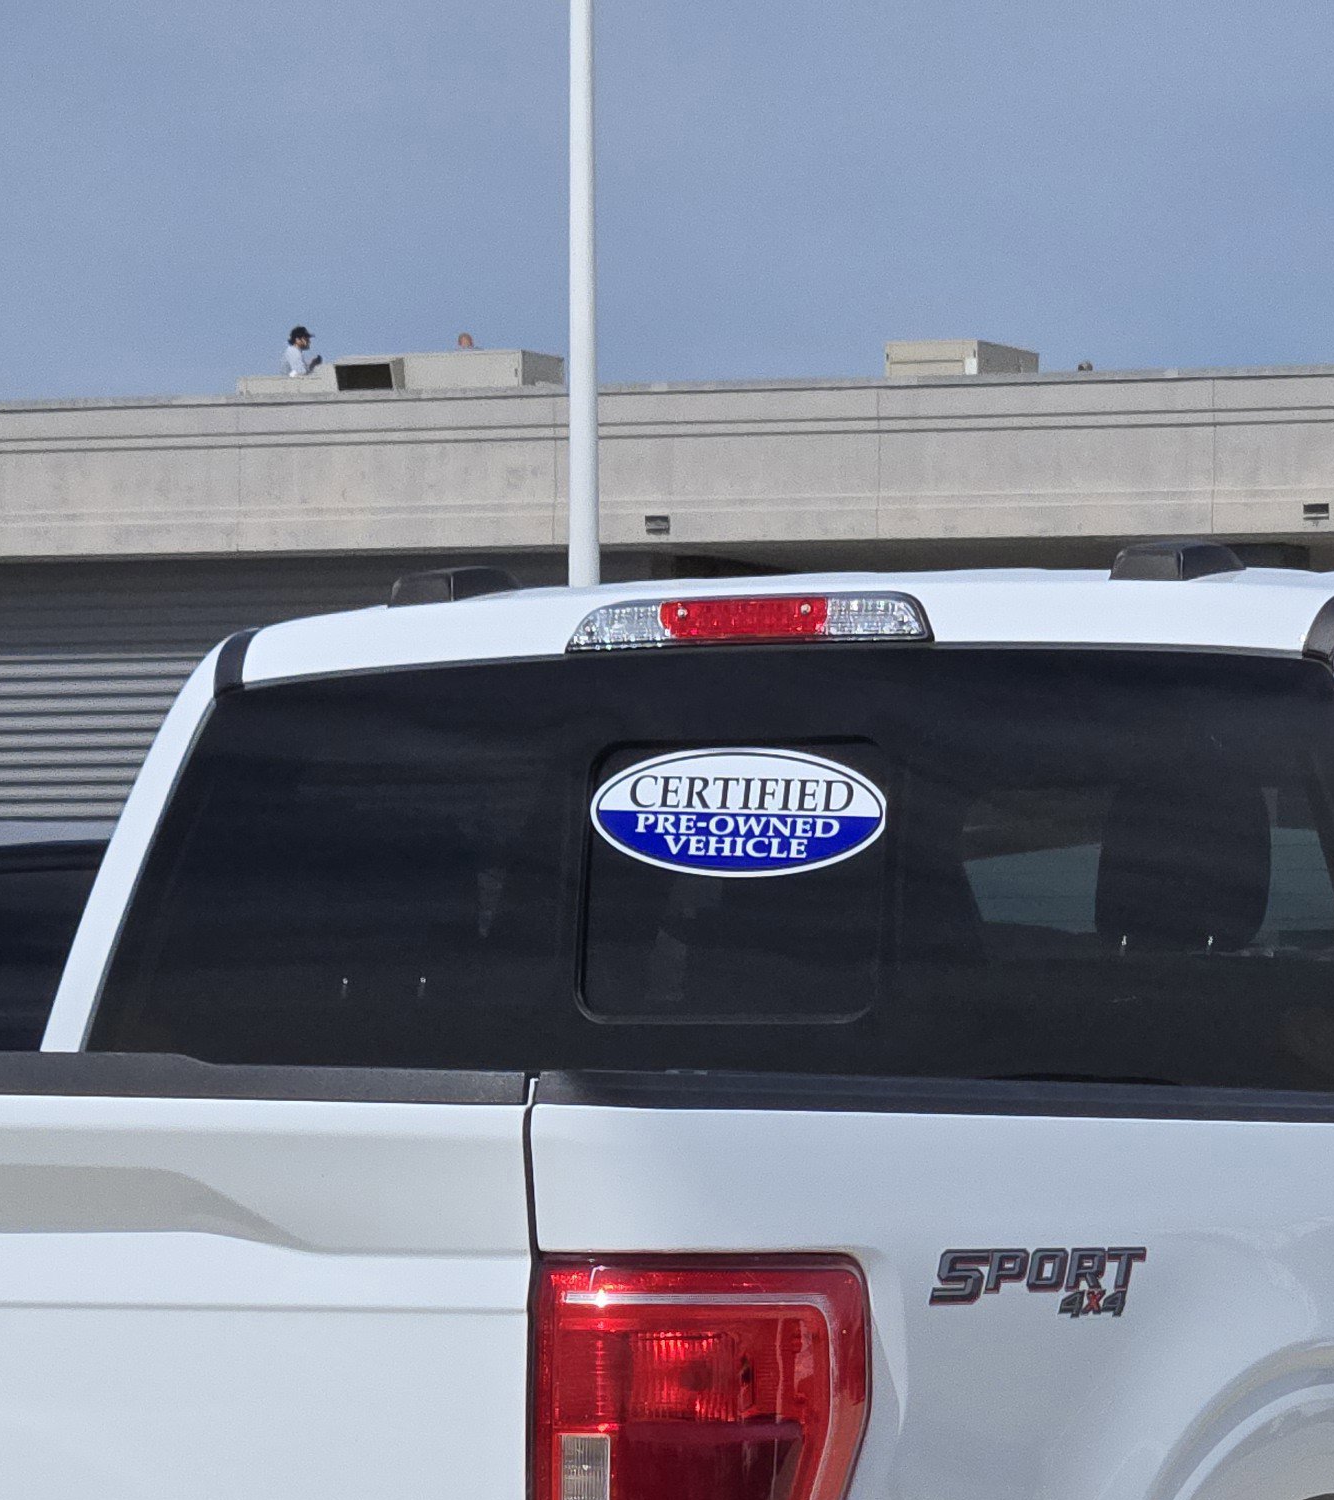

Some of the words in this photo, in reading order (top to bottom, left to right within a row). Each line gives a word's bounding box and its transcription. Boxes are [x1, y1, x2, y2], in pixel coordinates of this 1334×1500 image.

[630, 775, 854, 812] CERTIFIED
[635, 813, 840, 838] PRE-OWNED
[664, 835, 808, 860] VEHICLE
[929, 1247, 1147, 1306] SPORT
